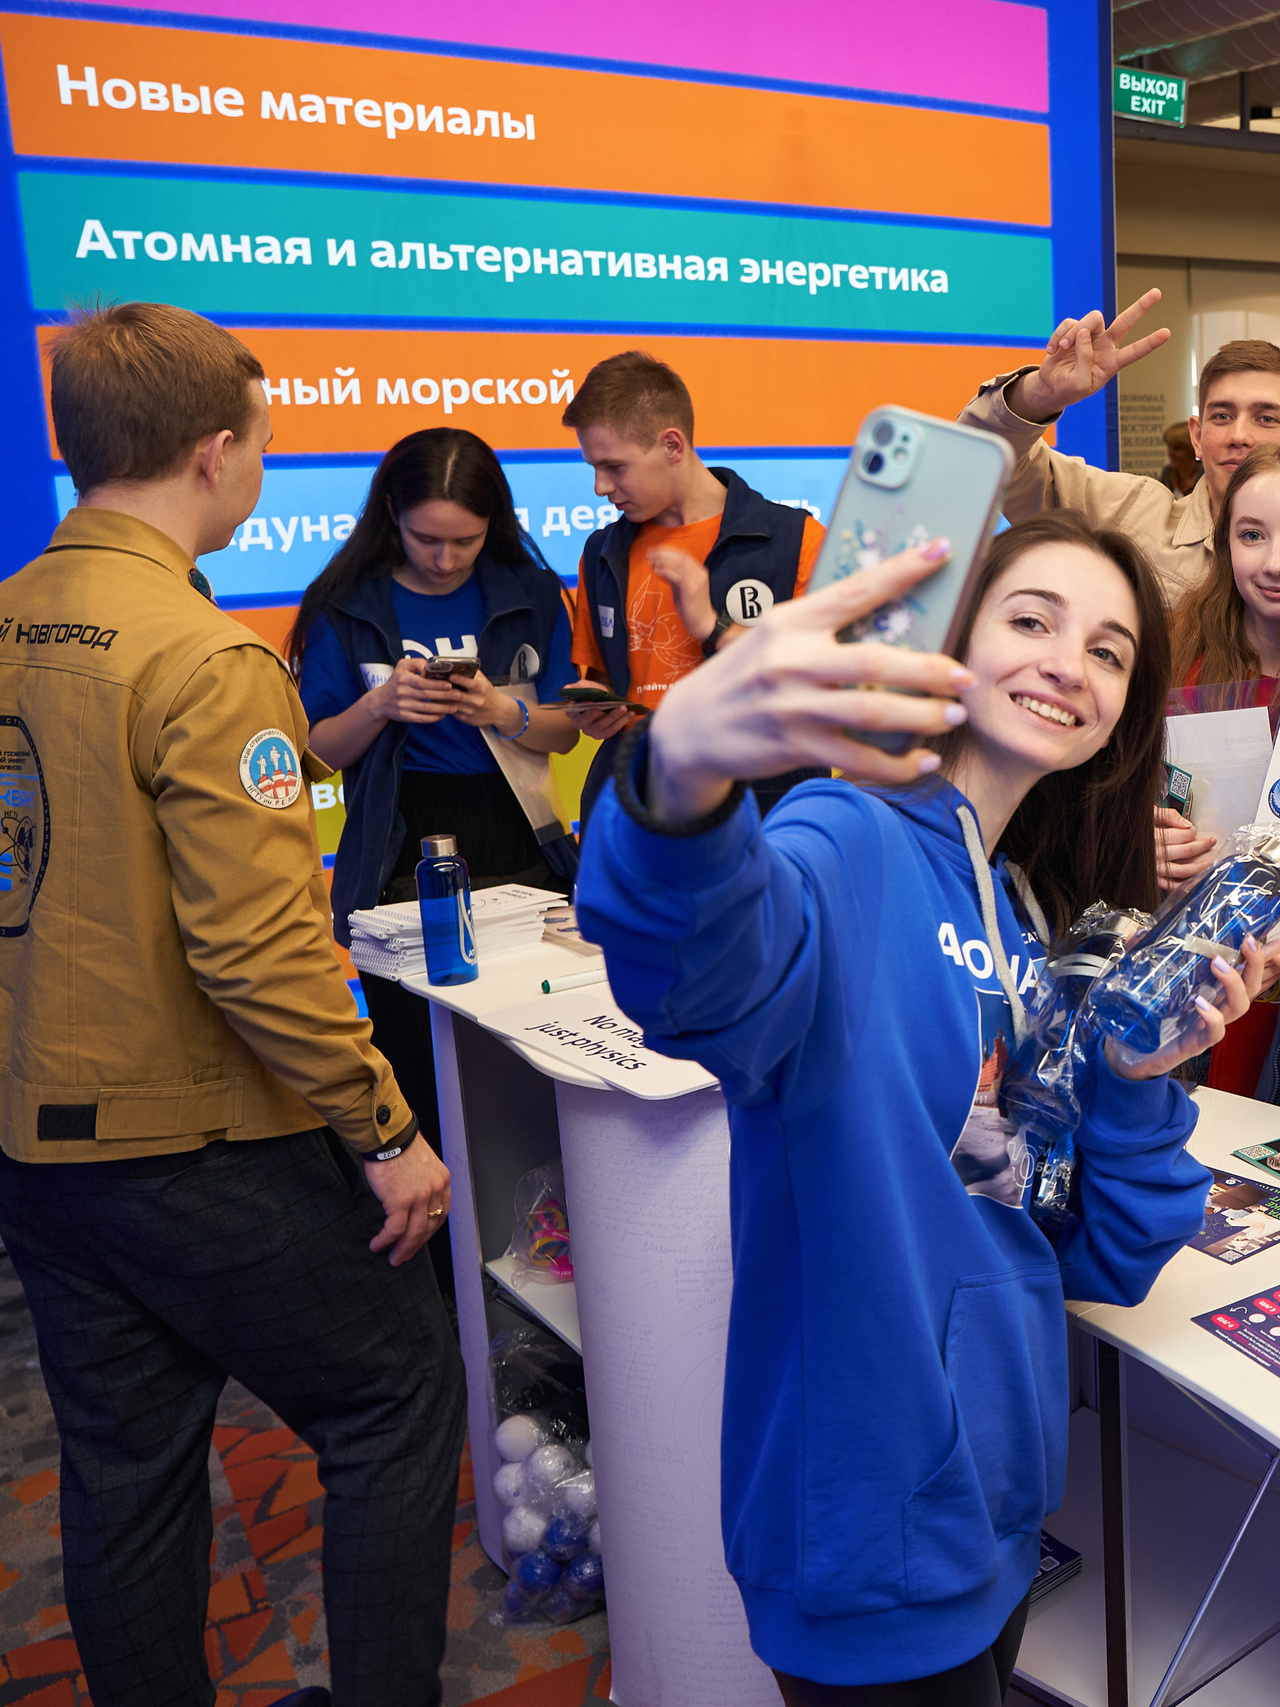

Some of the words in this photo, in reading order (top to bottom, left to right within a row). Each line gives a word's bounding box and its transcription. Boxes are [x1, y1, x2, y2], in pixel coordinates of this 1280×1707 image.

[57, 64, 245, 118] Новые
[260, 91, 536, 140] материалы
[1119, 73, 1178, 101] ВЫХОД
[1131, 95, 1166, 116] EXIT
[76, 220, 312, 266] Атомная
[327, 238, 356, 267] и
[370, 240, 729, 283] альтернативная
[739, 257, 949, 295] энергетика
[263, 367, 362, 406] ный
[376, 368, 576, 414] морской
[16, 623, 119, 651] НОВГОРОД
[583, 1015, 618, 1030] No
[524, 1020, 581, 1041] just
[561, 1040, 648, 1071] physics
